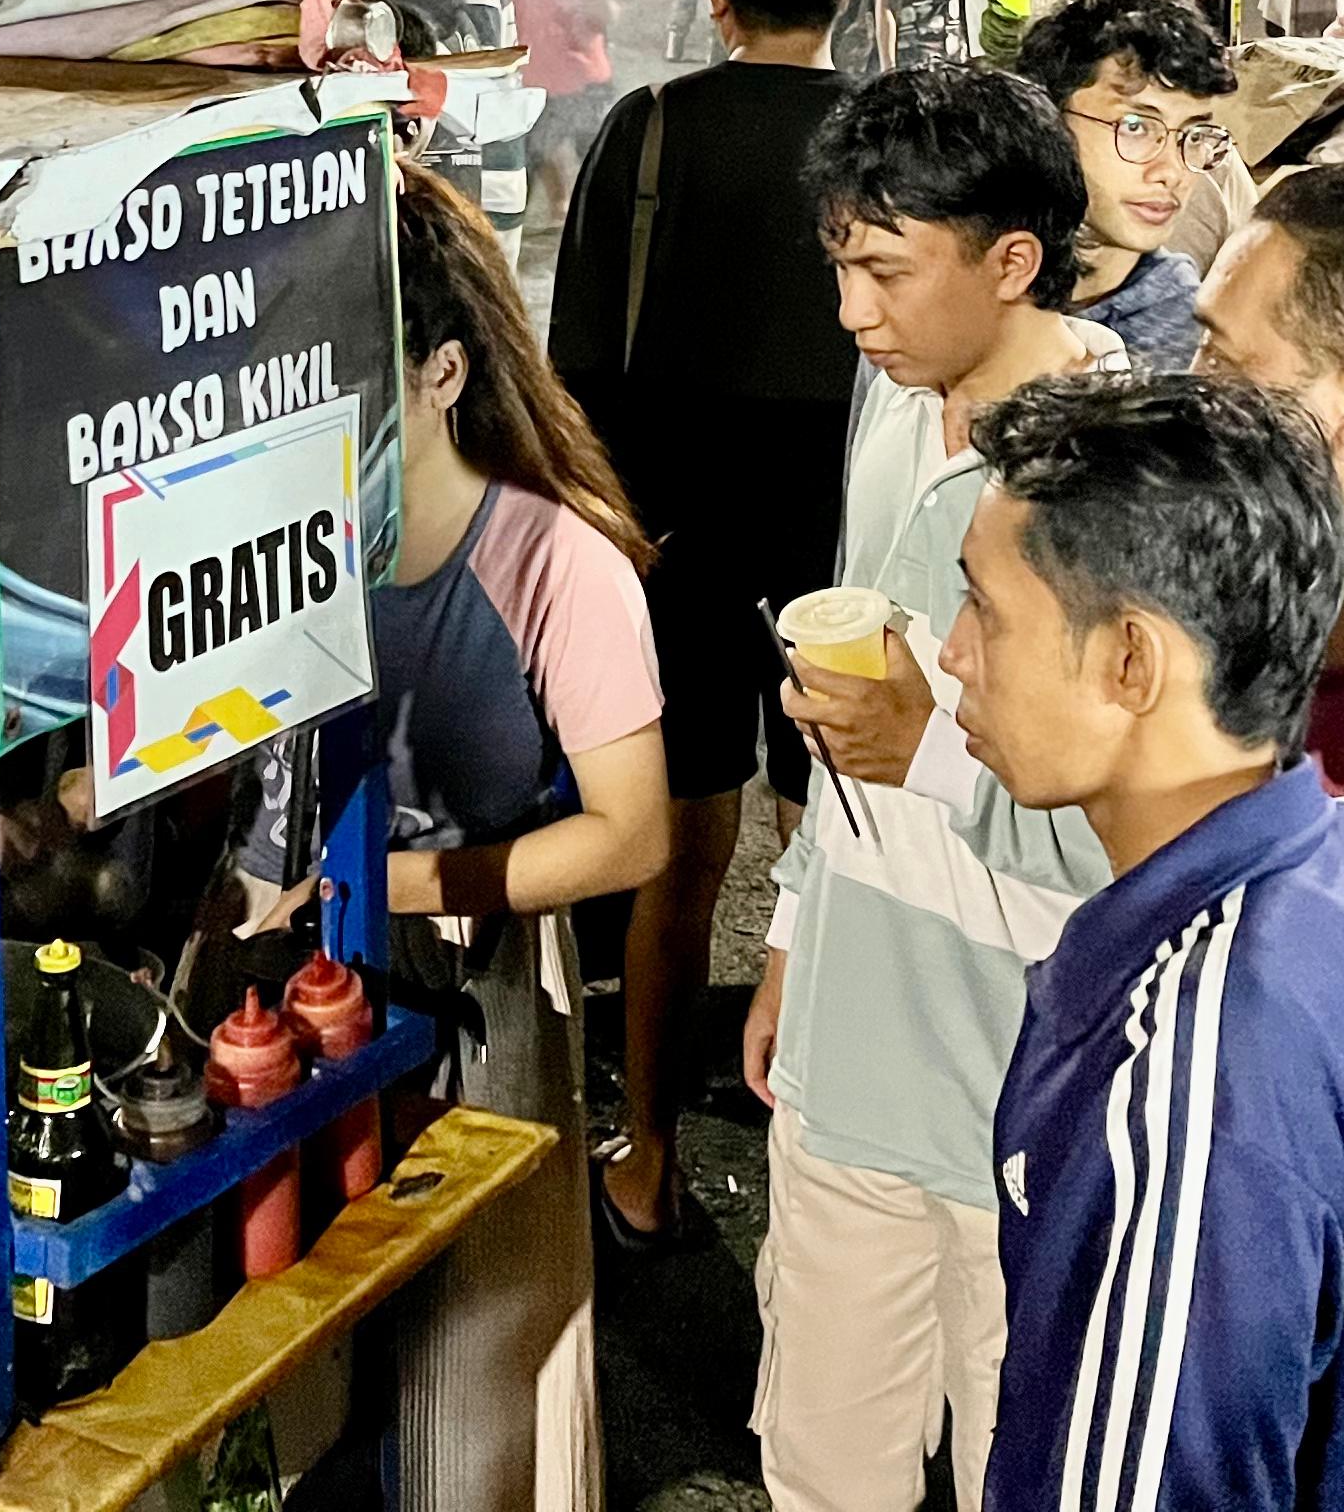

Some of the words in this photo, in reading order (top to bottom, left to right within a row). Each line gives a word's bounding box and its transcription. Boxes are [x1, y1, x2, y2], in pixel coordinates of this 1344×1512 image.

[197, 146, 368, 243] TETELAN
[159, 267, 256, 354] DAN
[66, 373, 226, 486] BAKSO
[239, 341, 340, 429] KIKIL
[146, 509, 338, 674] GRATIS
